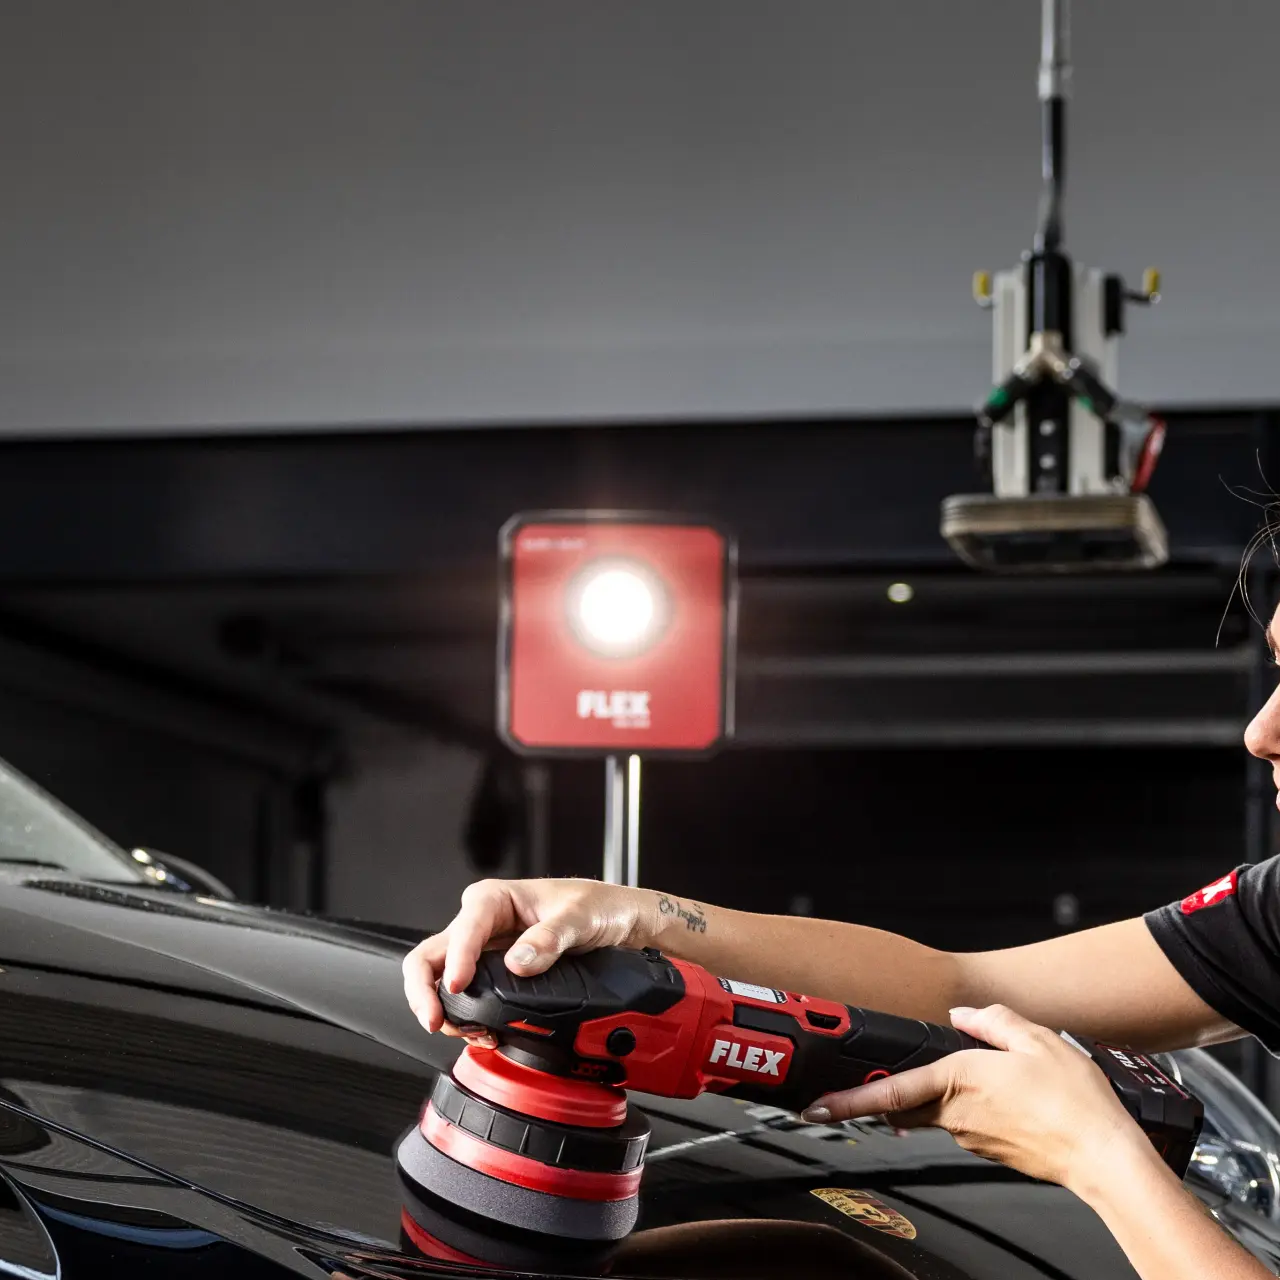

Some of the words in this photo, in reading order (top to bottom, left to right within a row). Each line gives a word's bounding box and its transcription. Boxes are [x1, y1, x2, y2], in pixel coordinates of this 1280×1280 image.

[577, 690, 651, 719] FLEX
[709, 1039, 786, 1076] FLEX
[1107, 1048, 1139, 1070] FLEX
